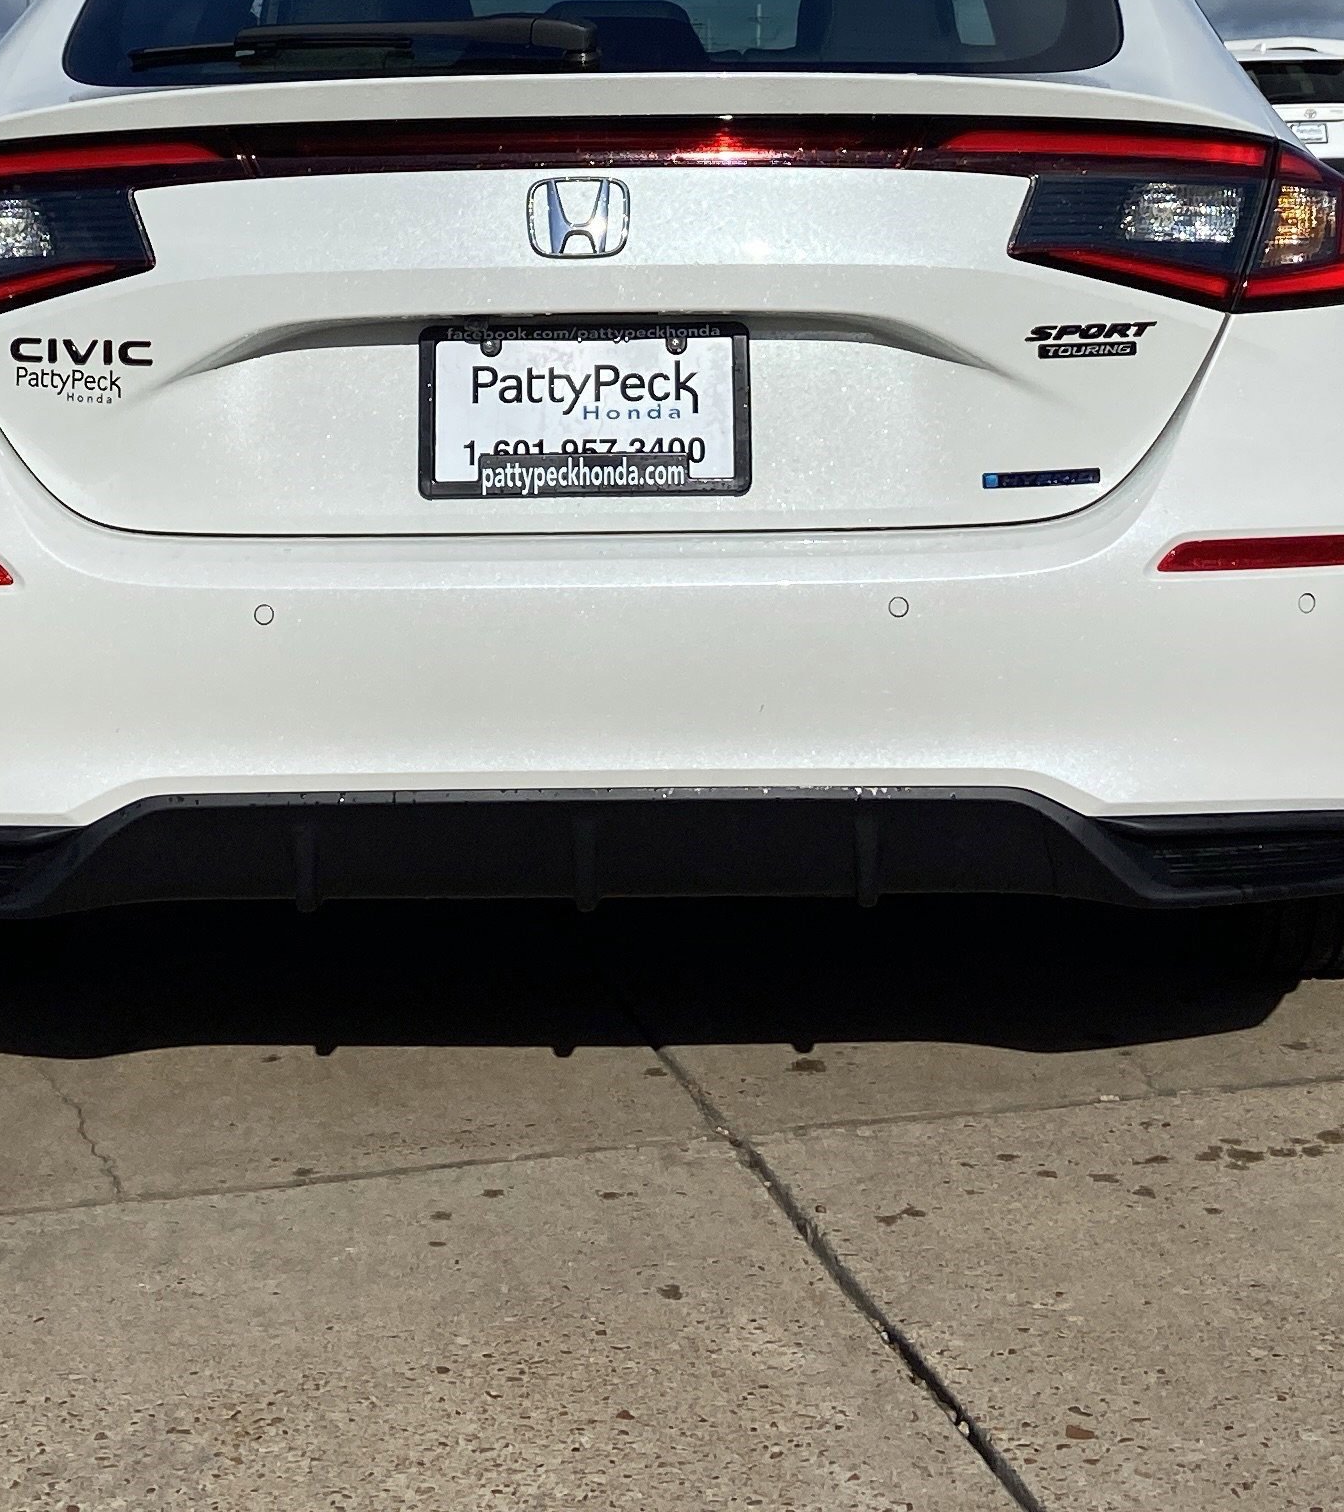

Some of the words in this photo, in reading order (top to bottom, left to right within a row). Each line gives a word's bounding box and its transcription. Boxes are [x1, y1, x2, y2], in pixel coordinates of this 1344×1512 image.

[446, 324, 721, 344] facebook.com/pattypeckhonda
[1025, 321, 1158, 342] SPORT
[10, 337, 154, 367] CIVIC
[1045, 343, 1132, 357] TOURING
[16, 366, 122, 399] PattyPeck
[471, 360, 700, 415] PattyPeck
[66, 392, 113, 405] Honda
[582, 404, 682, 421] Honda
[481, 456, 685, 496] pattypeckhonda.com
